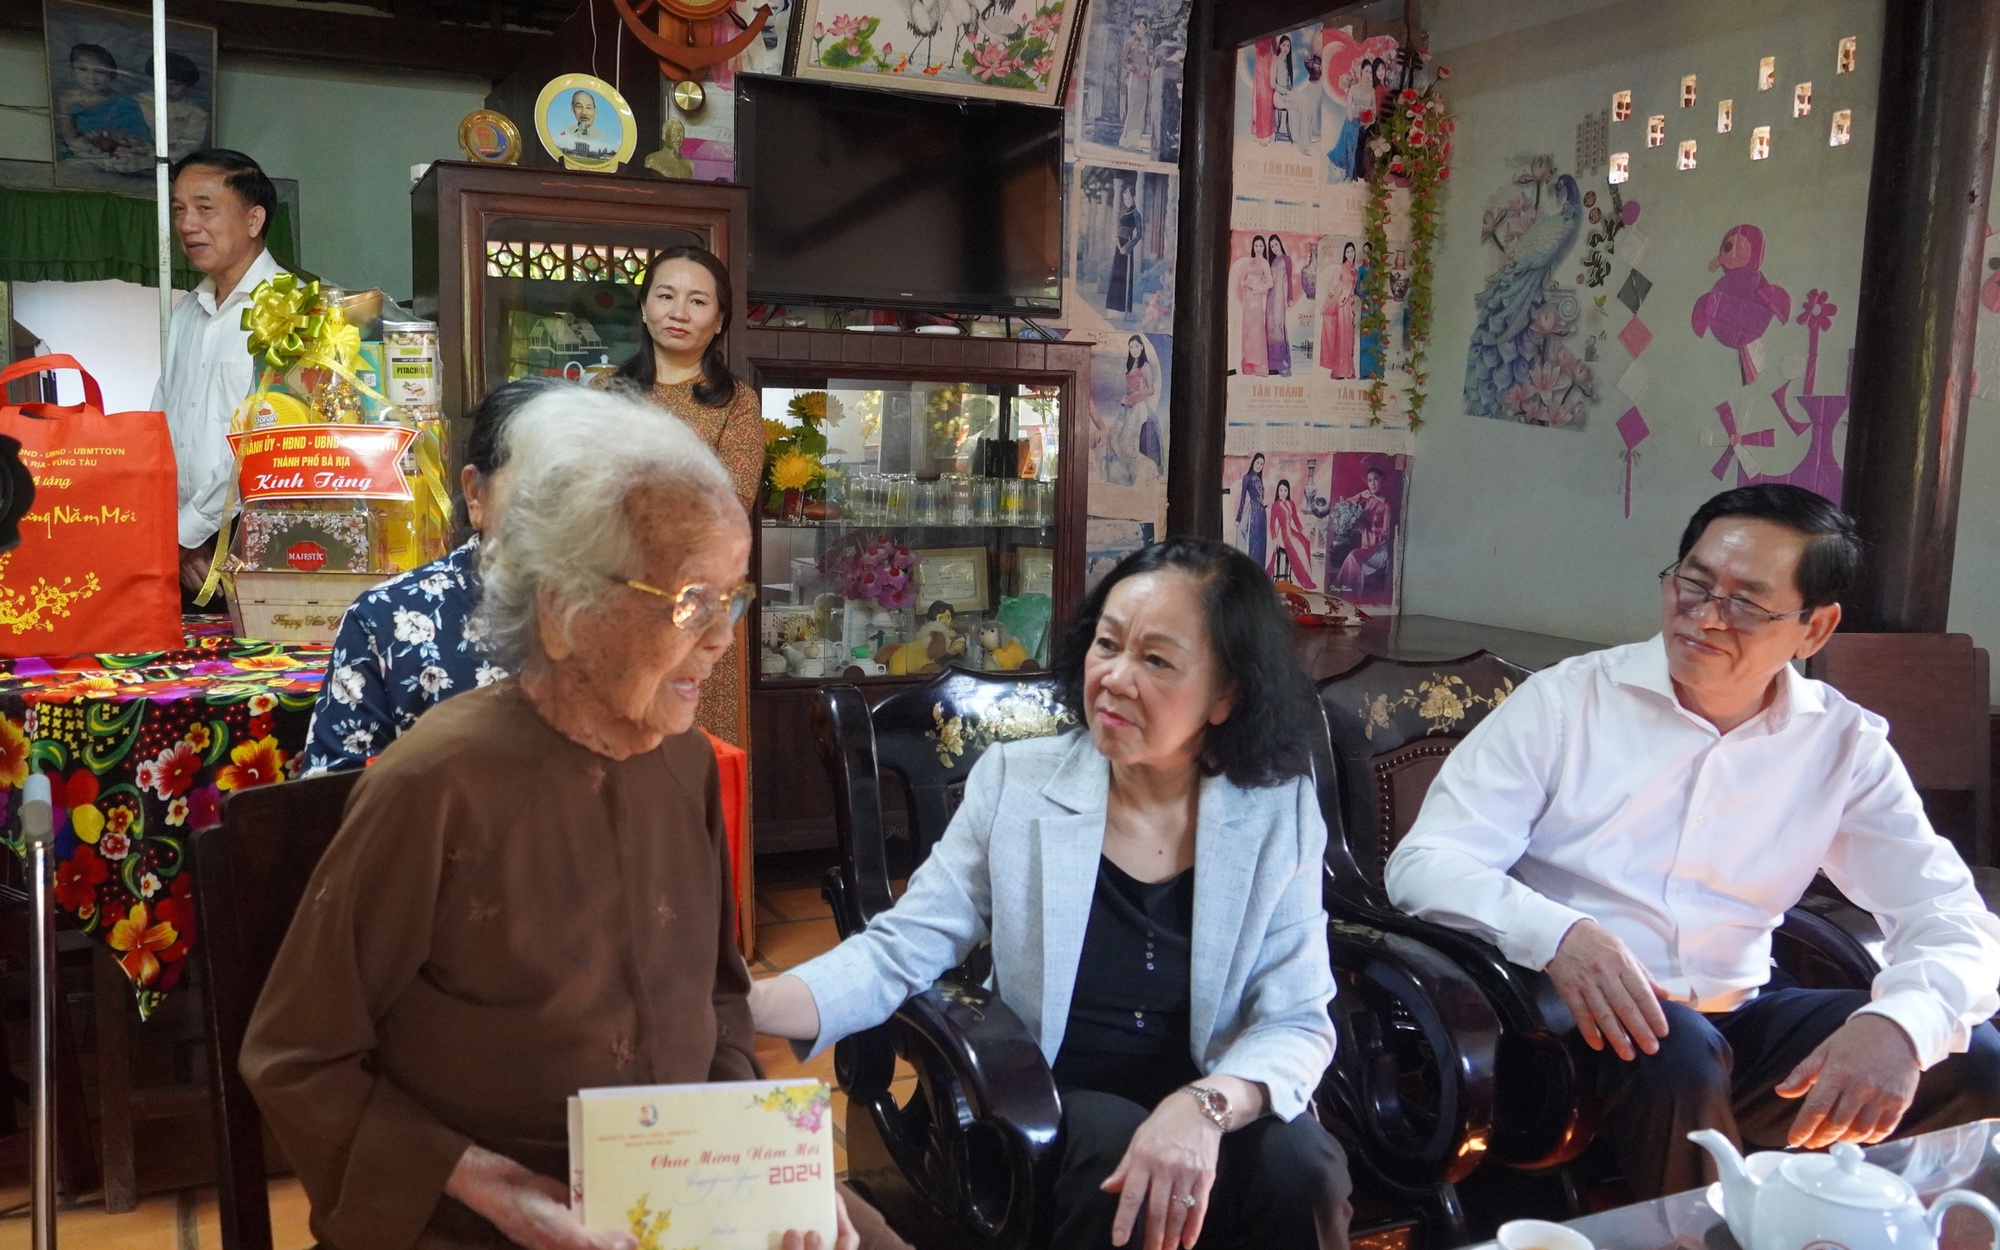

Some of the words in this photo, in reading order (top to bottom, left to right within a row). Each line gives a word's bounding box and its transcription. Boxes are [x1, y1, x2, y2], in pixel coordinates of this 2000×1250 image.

[264, 434, 275, 451] ỦY
[282, 436, 307, 450] HĐND
[314, 435, 340, 449] UBND
[45, 448, 66, 458] UBND
[73, 447, 125, 455] UBMTTQVN
[30, 459, 46, 469] RỊA
[79, 458, 97, 466] TÀU
[273, 454, 300, 468] THÀNH
[301, 453, 320, 467] PHỐ
[321, 454, 334, 467] BÀ
[335, 456, 350, 469] RỊA
[43, 476, 72, 489] tặng
[250, 472, 305, 491] Kính
[313, 472, 373, 491] Tặng
[54, 505, 100, 526] Năm
[101, 505, 136, 524] Mới
[288, 552, 324, 560] MAJESTIC
[650, 1153, 690, 1170] Chúc
[697, 1149, 741, 1166] Mừng
[747, 1146, 786, 1161] Năm
[794, 1142, 820, 1157] Mới
[769, 1163, 821, 1185] 2024
